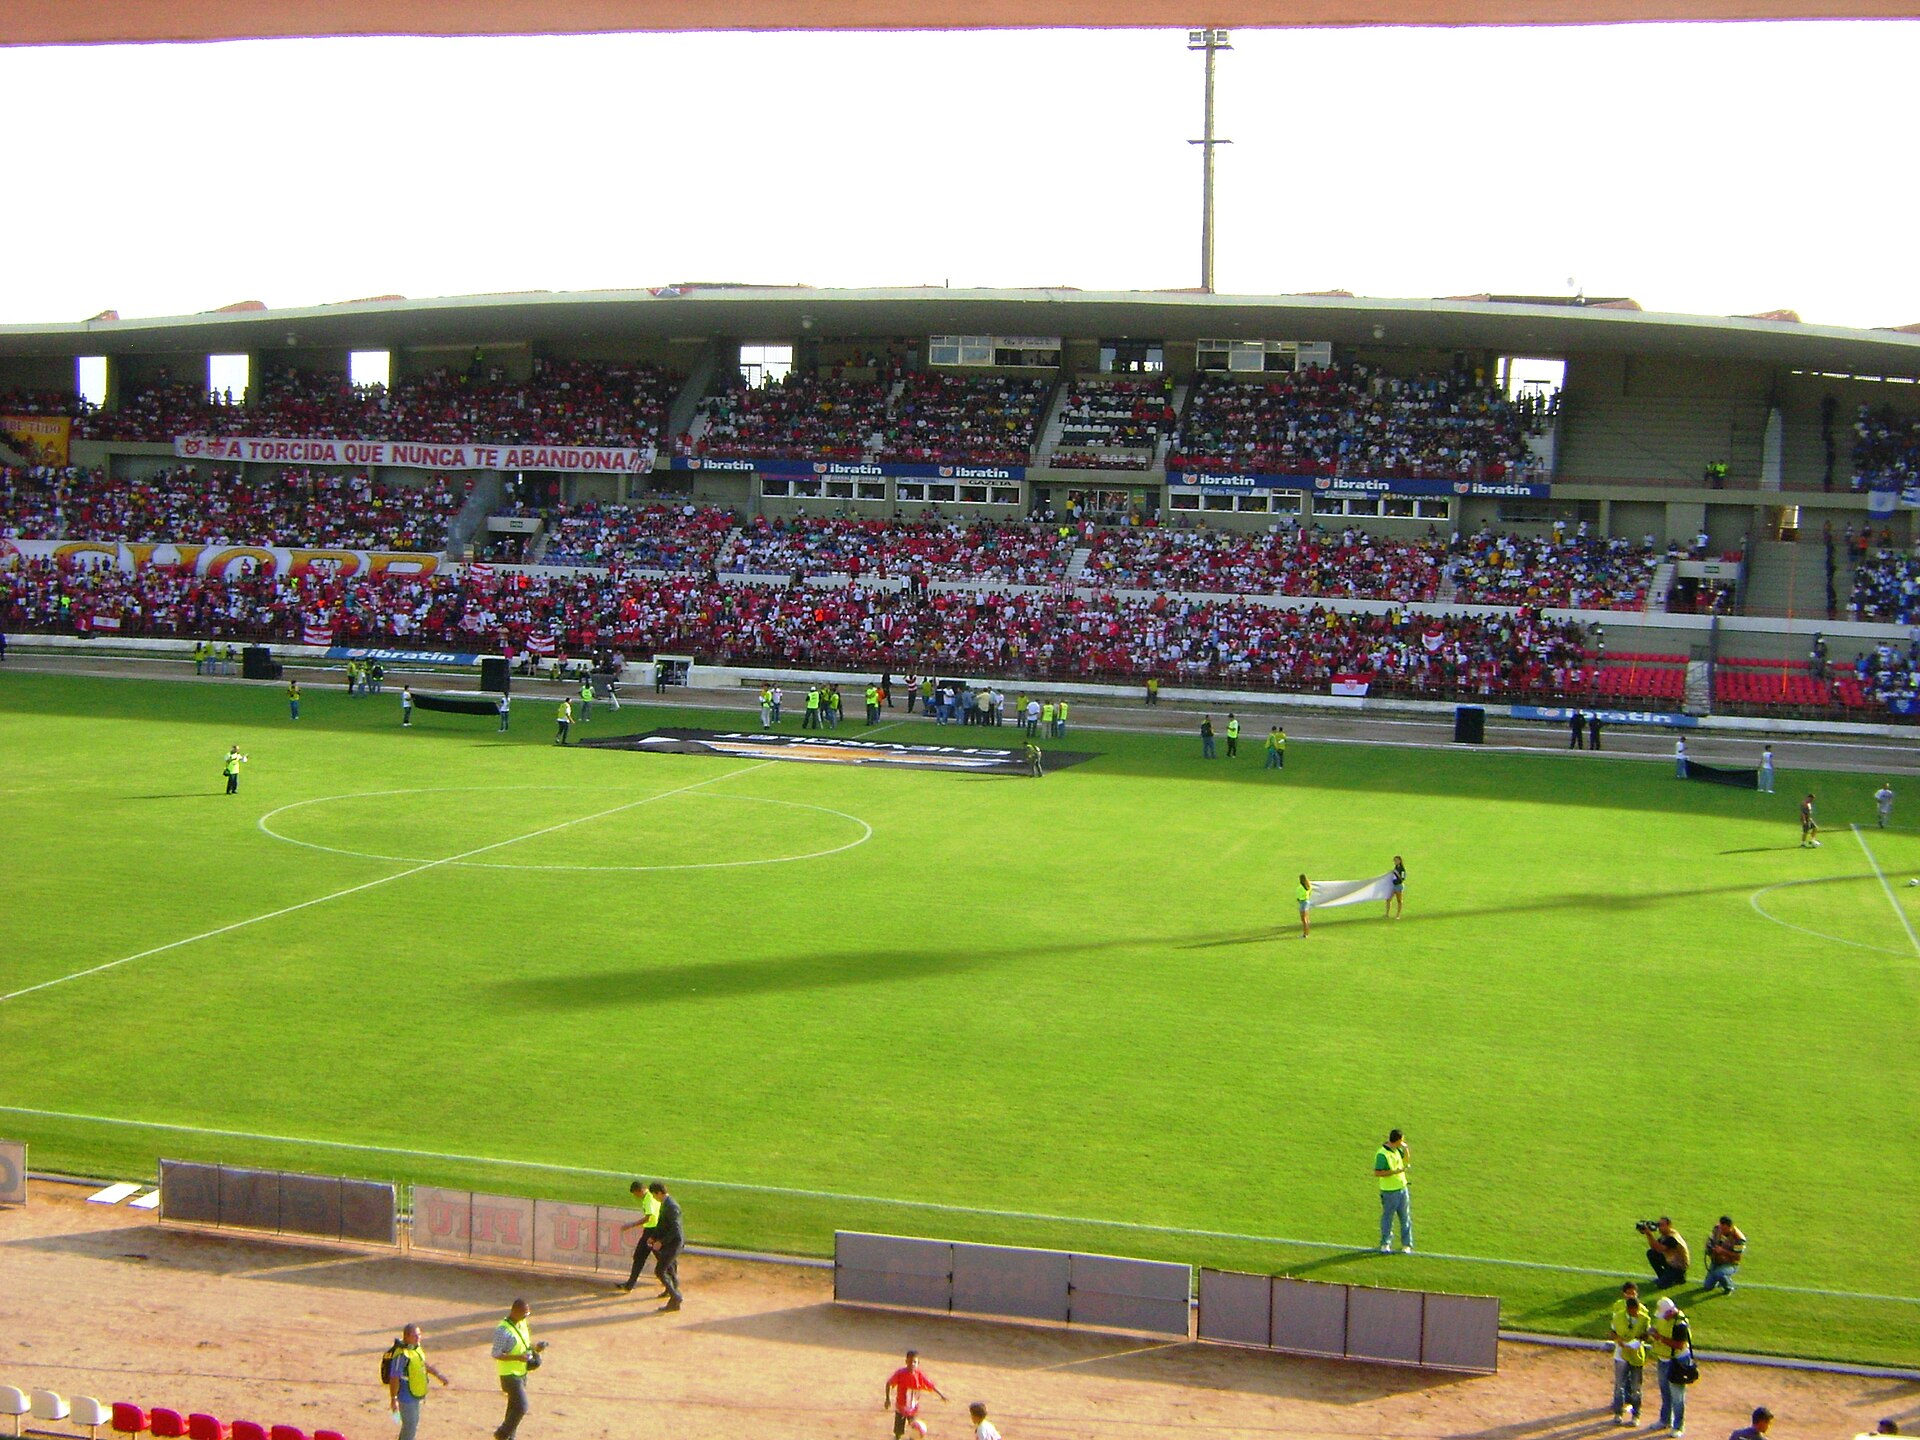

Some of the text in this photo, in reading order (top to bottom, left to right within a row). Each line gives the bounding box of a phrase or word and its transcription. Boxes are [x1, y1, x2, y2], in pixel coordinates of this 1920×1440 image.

[227, 440, 242, 458] A
[248, 441, 337, 462] TORCIDA
[344, 443, 384, 463] QUE
[391, 444, 466, 467] NUNCA
[473, 447, 498, 467] TE
[703, 459, 754, 470] ibratin
[829, 463, 882, 475] ibratin
[955, 466, 1009, 479] ibratin
[968, 479, 1012, 487] GAZETA
[1200, 474, 1255, 486] ibratin
[1333, 478, 1390, 490] ibratin
[1472, 483, 1531, 496] ibratin
[367, 648, 456, 661] ibratin
